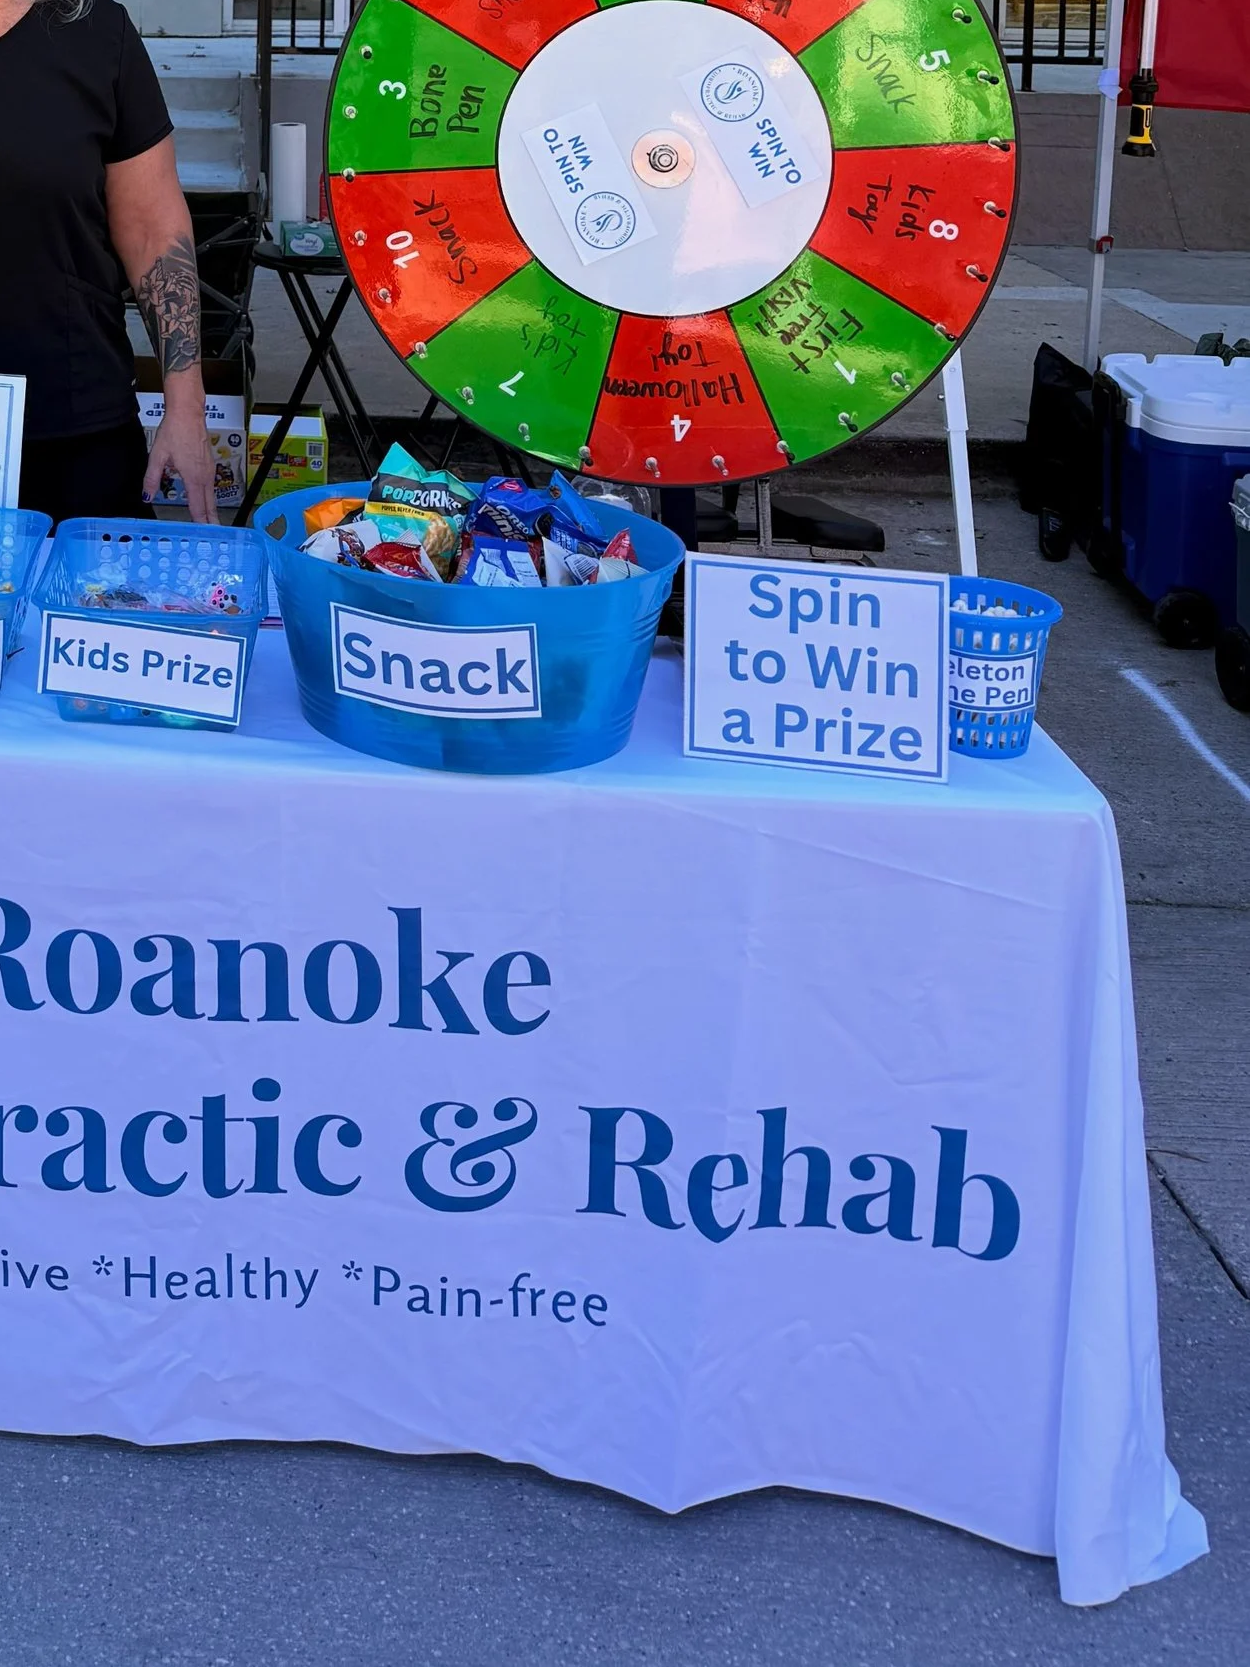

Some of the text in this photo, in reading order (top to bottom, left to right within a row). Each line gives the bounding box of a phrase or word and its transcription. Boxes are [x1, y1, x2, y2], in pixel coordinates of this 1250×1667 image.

[919, 49, 950, 72] 5
[379, 80, 407, 100] 3
[409, 64, 447, 139] Bone
[446, 85, 487, 134] Pen
[543, 128, 585, 194] SPIN TO
[568, 135, 594, 171] WIN
[748, 142, 776, 179] WIN
[756, 118, 802, 184] SPIN TO
[847, 174, 893, 235] Toy
[895, 184, 937, 242] Kids
[385, 230, 421, 270] 10
[412, 189, 478, 285] Snack
[928, 219, 959, 242] 8
[788, 308, 865, 375] First
[498, 370, 525, 398] 7
[603, 372, 746, 408] Halloween
[833, 360, 858, 385] 1
[670, 414, 692, 443] 4
[495, 504, 529, 534] OREO
[748, 573, 881, 634] Spin
[51, 636, 234, 690] Kids Prize
[343, 631, 531, 697] Snack
[724, 639, 919, 699] to Win
[985, 686, 1029, 706] Pen
[722, 702, 923, 763] a Prize
[404, 1097, 538, 1213] &
[575, 1105, 1021, 1262] Rehab
